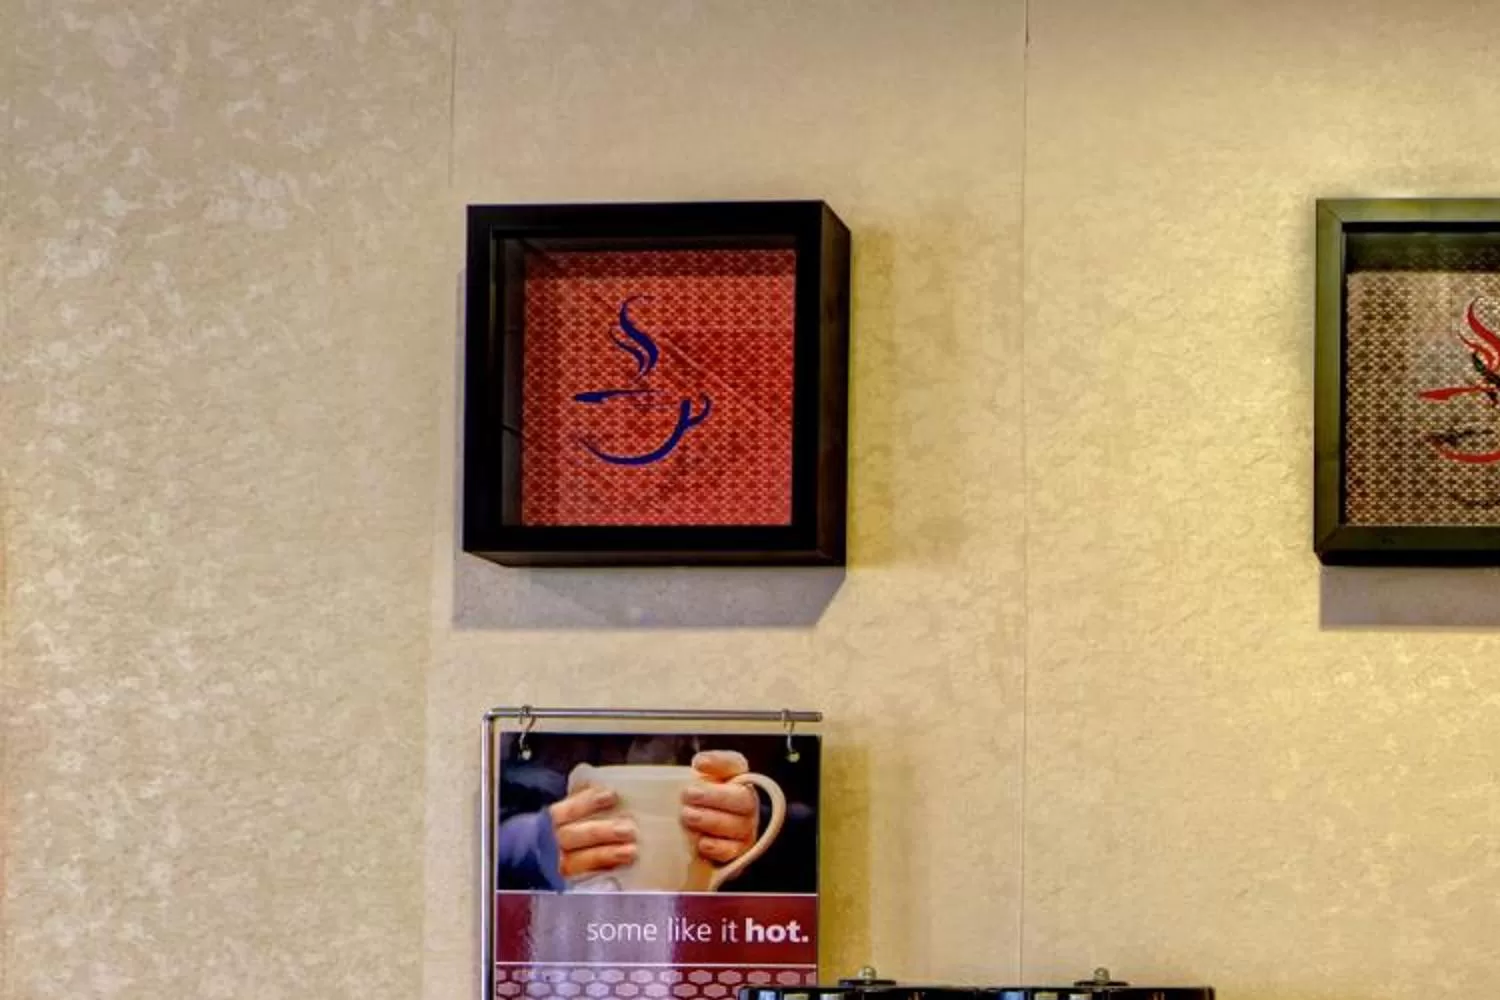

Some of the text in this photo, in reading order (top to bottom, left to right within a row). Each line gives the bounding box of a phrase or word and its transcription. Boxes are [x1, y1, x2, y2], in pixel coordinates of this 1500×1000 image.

[586, 916, 809, 943] some like it hot.
